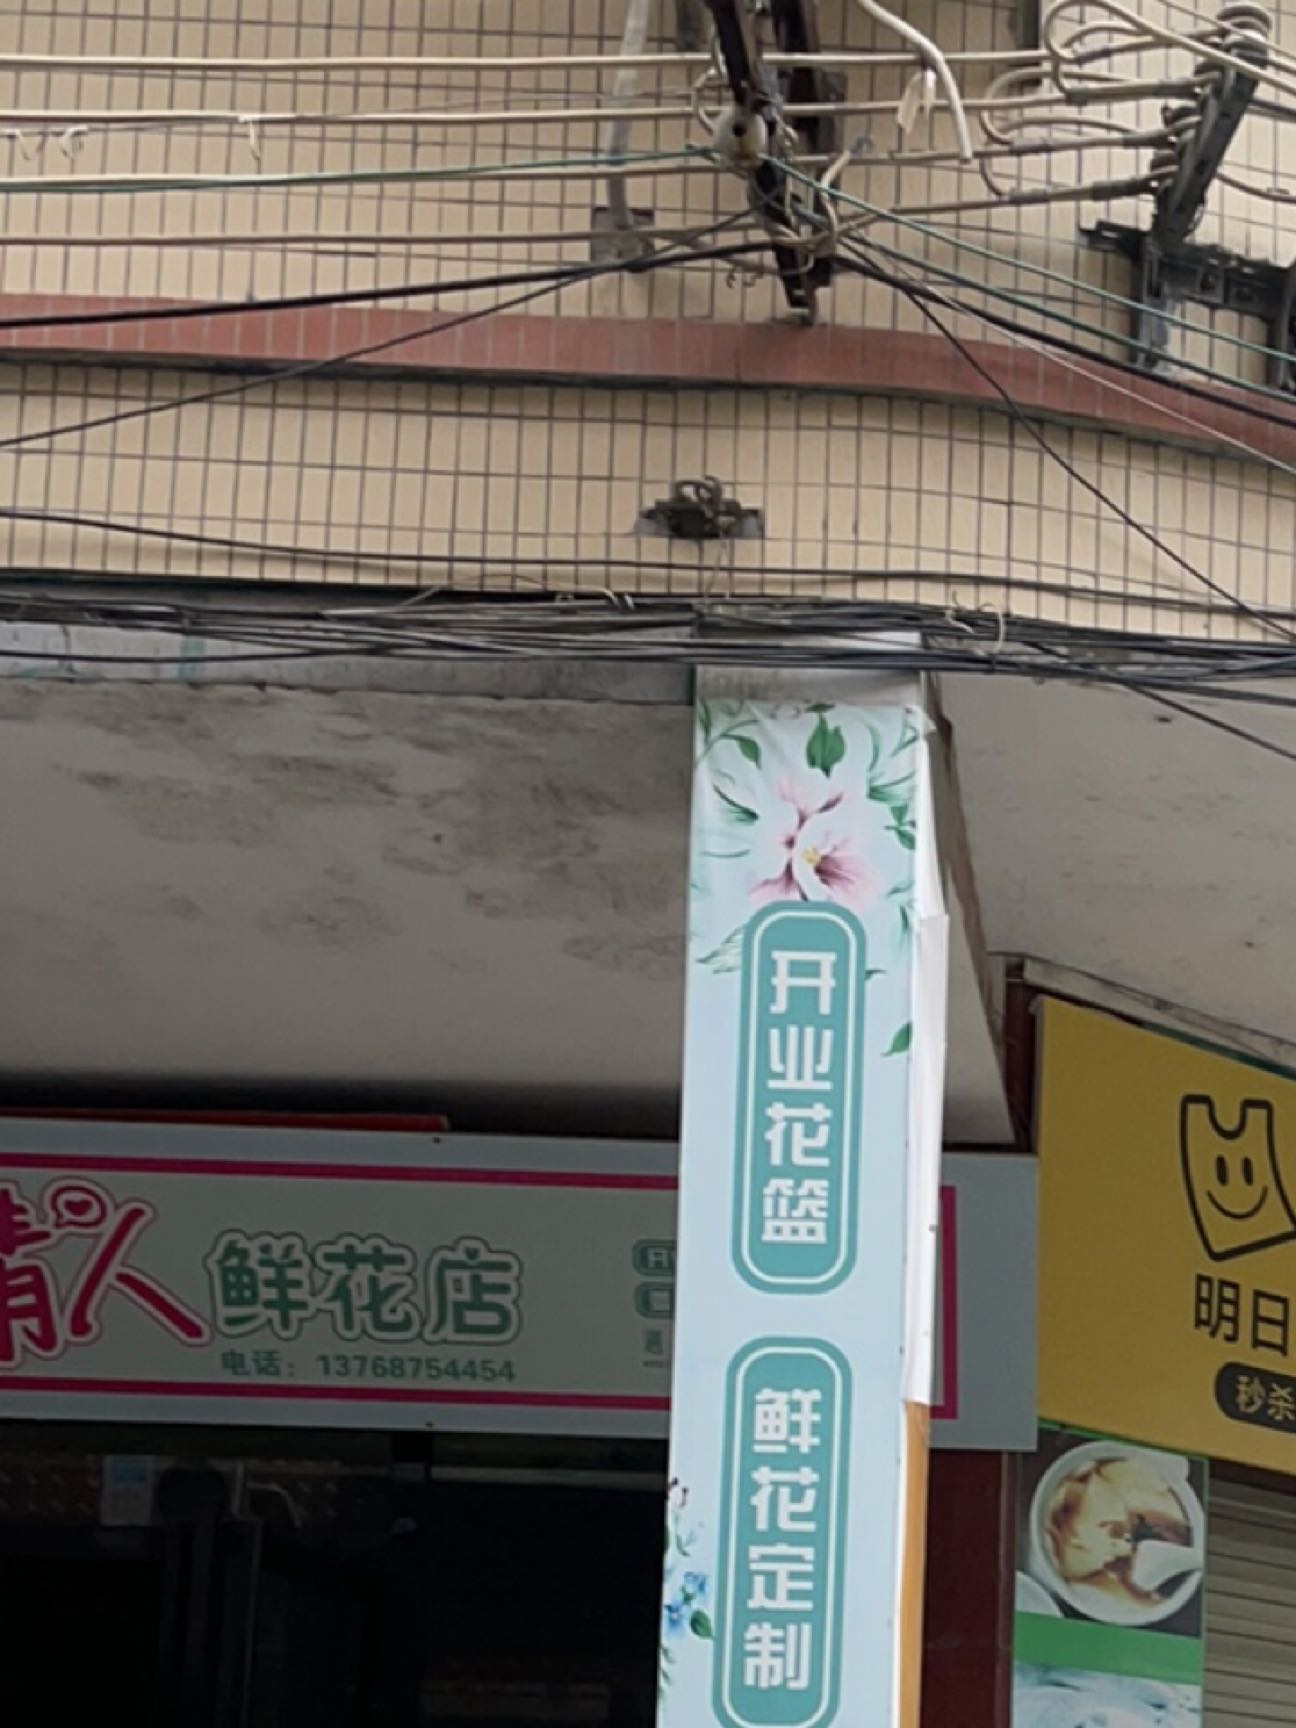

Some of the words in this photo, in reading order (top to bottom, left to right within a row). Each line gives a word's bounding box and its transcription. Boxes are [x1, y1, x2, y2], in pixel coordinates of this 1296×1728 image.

[760, 949, 836, 1245] 开业花篮
[208, 1234, 518, 1342] 鲜花店
[316, 1354, 516, 1382] 13768754454
[743, 1387, 822, 1690] 鲜花定制
